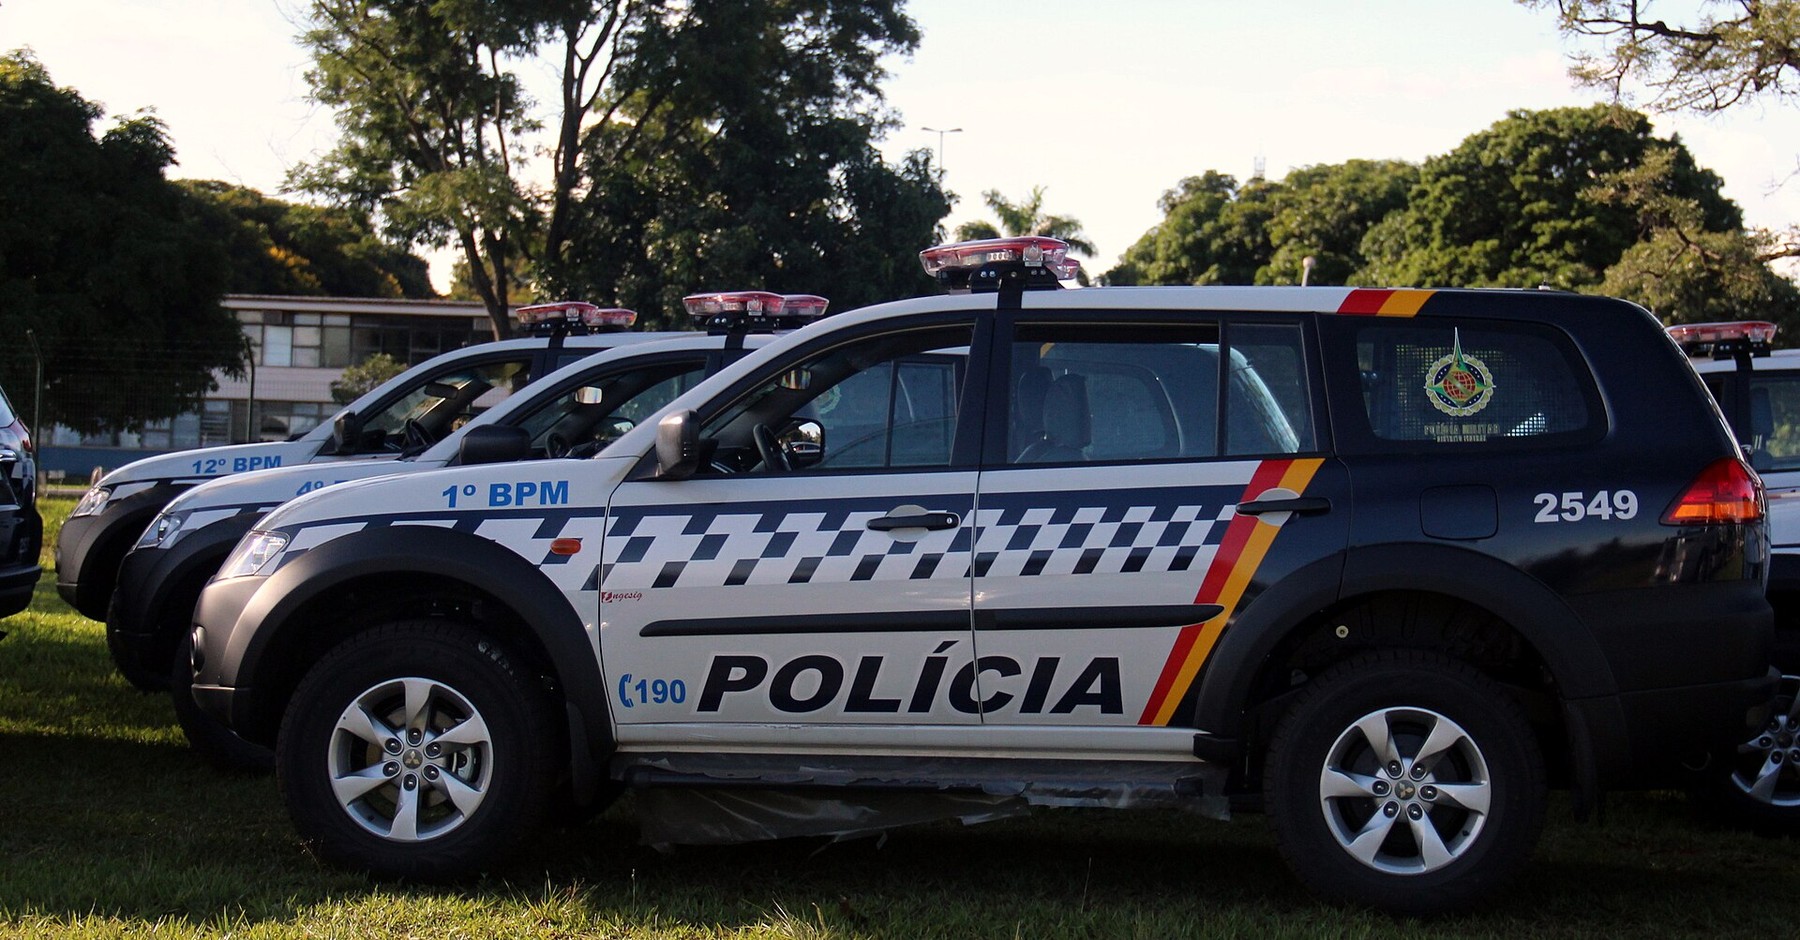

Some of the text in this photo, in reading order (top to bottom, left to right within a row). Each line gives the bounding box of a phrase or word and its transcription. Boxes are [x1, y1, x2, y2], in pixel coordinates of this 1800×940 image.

[192, 455, 282, 474] 12º BPM
[442, 480, 569, 508] 1º BPM
[1533, 489, 1639, 523] 2549
[634, 677, 687, 704] 190
[696, 639, 1125, 715] POLÍCIA
